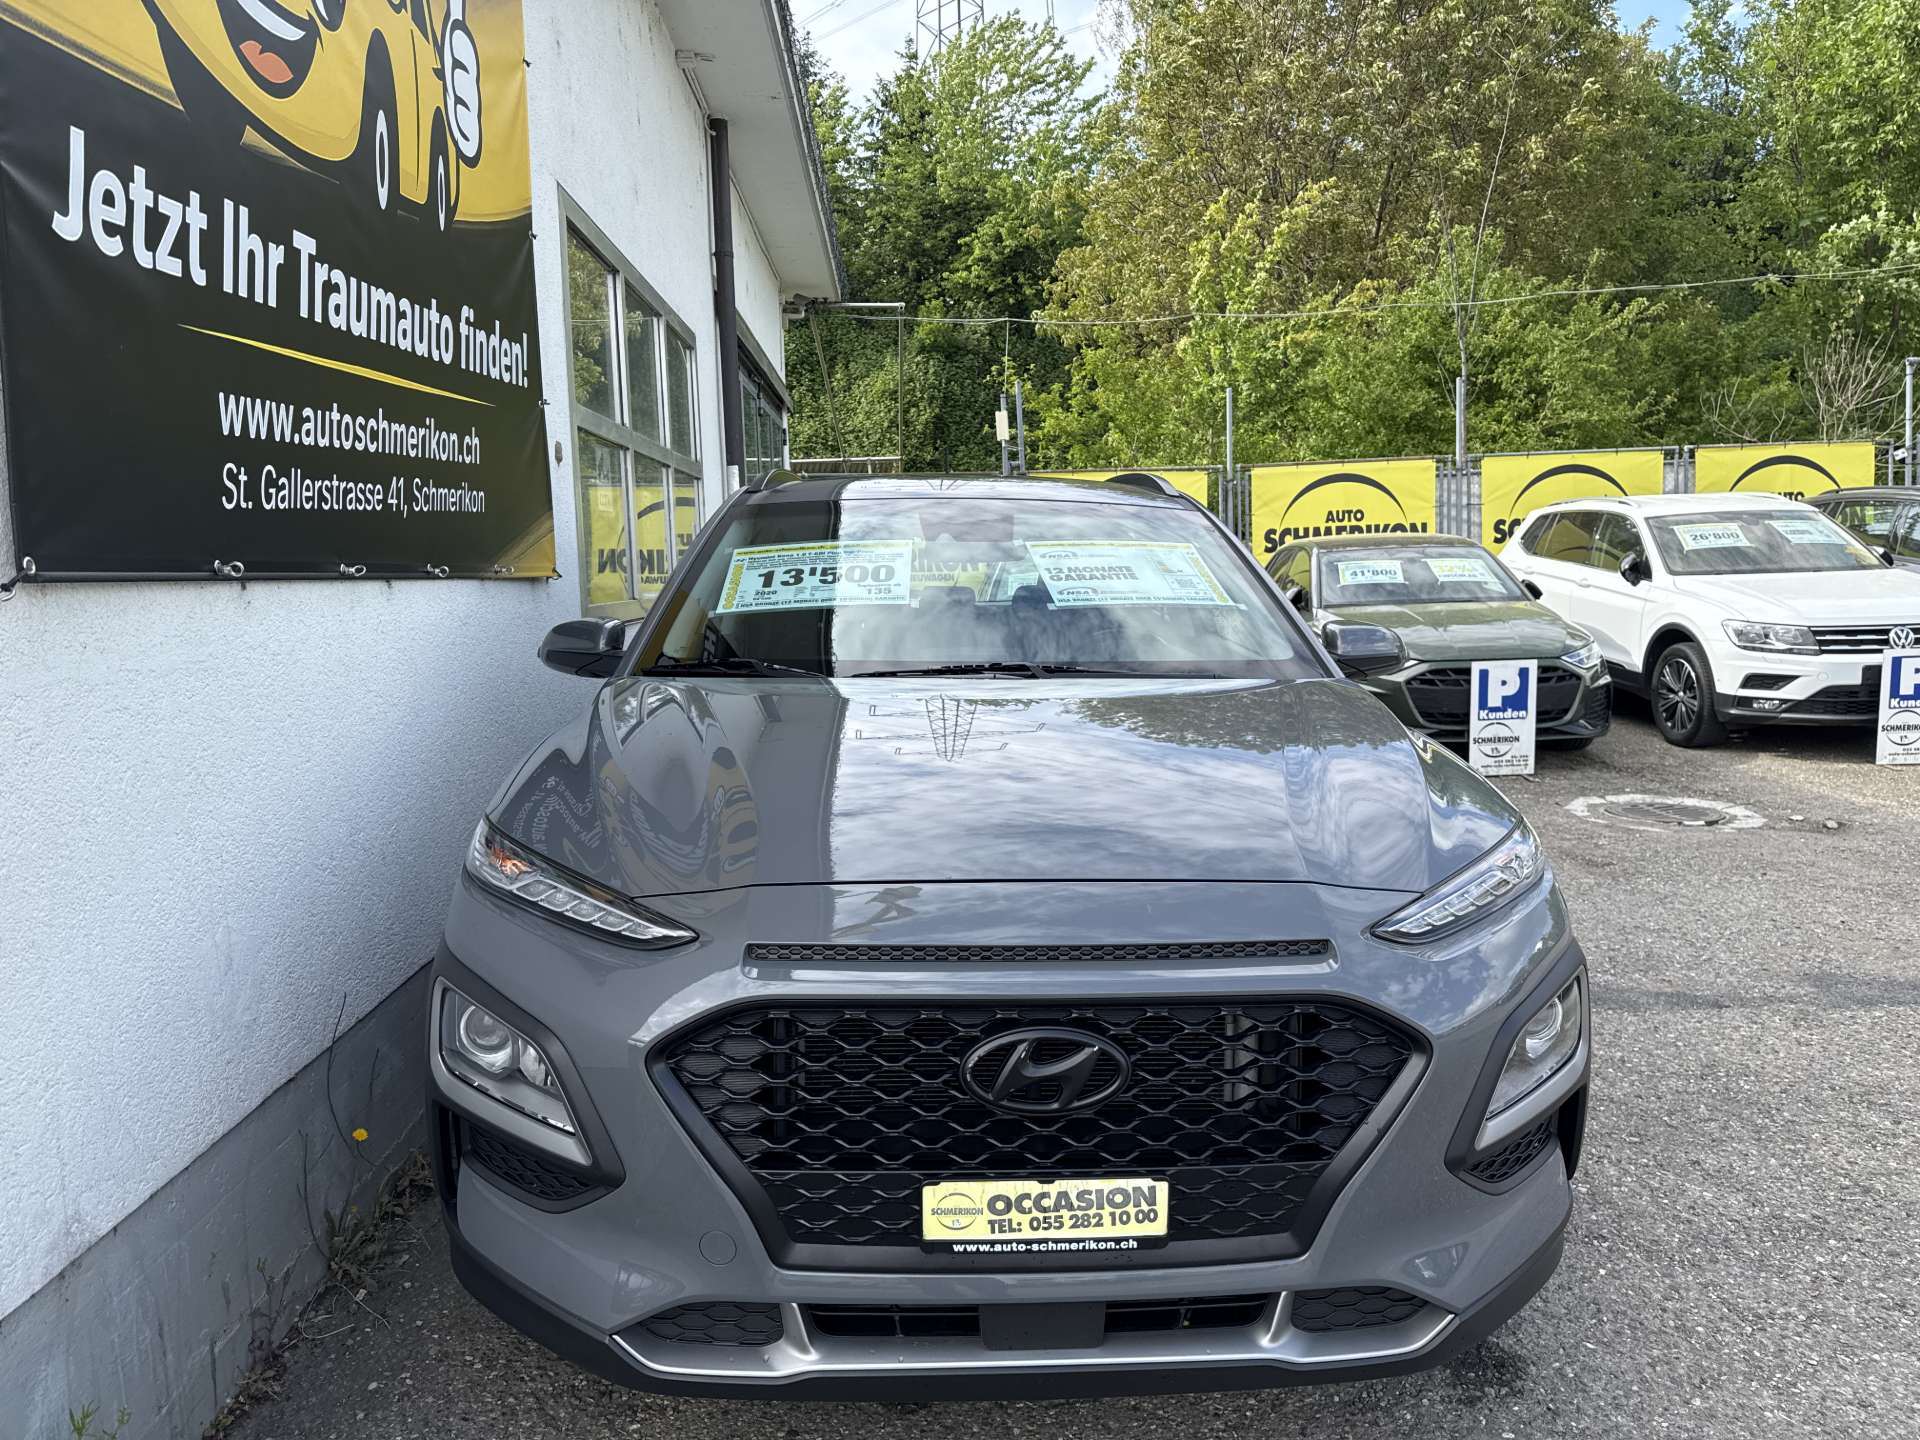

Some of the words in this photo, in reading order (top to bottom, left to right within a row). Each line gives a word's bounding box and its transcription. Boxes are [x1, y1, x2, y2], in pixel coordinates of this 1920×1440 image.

[52, 125, 207, 287] Jetzt
[223, 198, 285, 309] Ihr
[293, 230, 455, 366] Traumauto
[460, 304, 529, 389] finden!
[219, 392, 480, 466] www.autoschmerikon.ch
[222, 463, 254, 512] St.
[261, 465, 384, 513] Gallerstrasse
[388, 476, 409, 520] 41,
[413, 478, 486, 514] Schmerikon
[1325, 509, 1365, 523] AUTO
[758, 564, 896, 588] 13'500
[1049, 572, 1139, 581] GARANTIE
[1066, 565, 1133, 574] MONATE
[1479, 708, 1527, 720] Kunden
[1473, 735, 1520, 745] SCHMERIKON
[987, 1185, 1157, 1217] OCCASION
[931, 1207, 984, 1216] SCHMERIKON
[987, 1218, 1022, 1234] TEL:
[1029, 1215, 1064, 1232] 055
[1068, 1212, 1103, 1229] 282
[1109, 1210, 1130, 1227] 10
[1134, 1208, 1159, 1225] 00
[953, 1238, 1138, 1252] www.auto-schmerikon.ch
